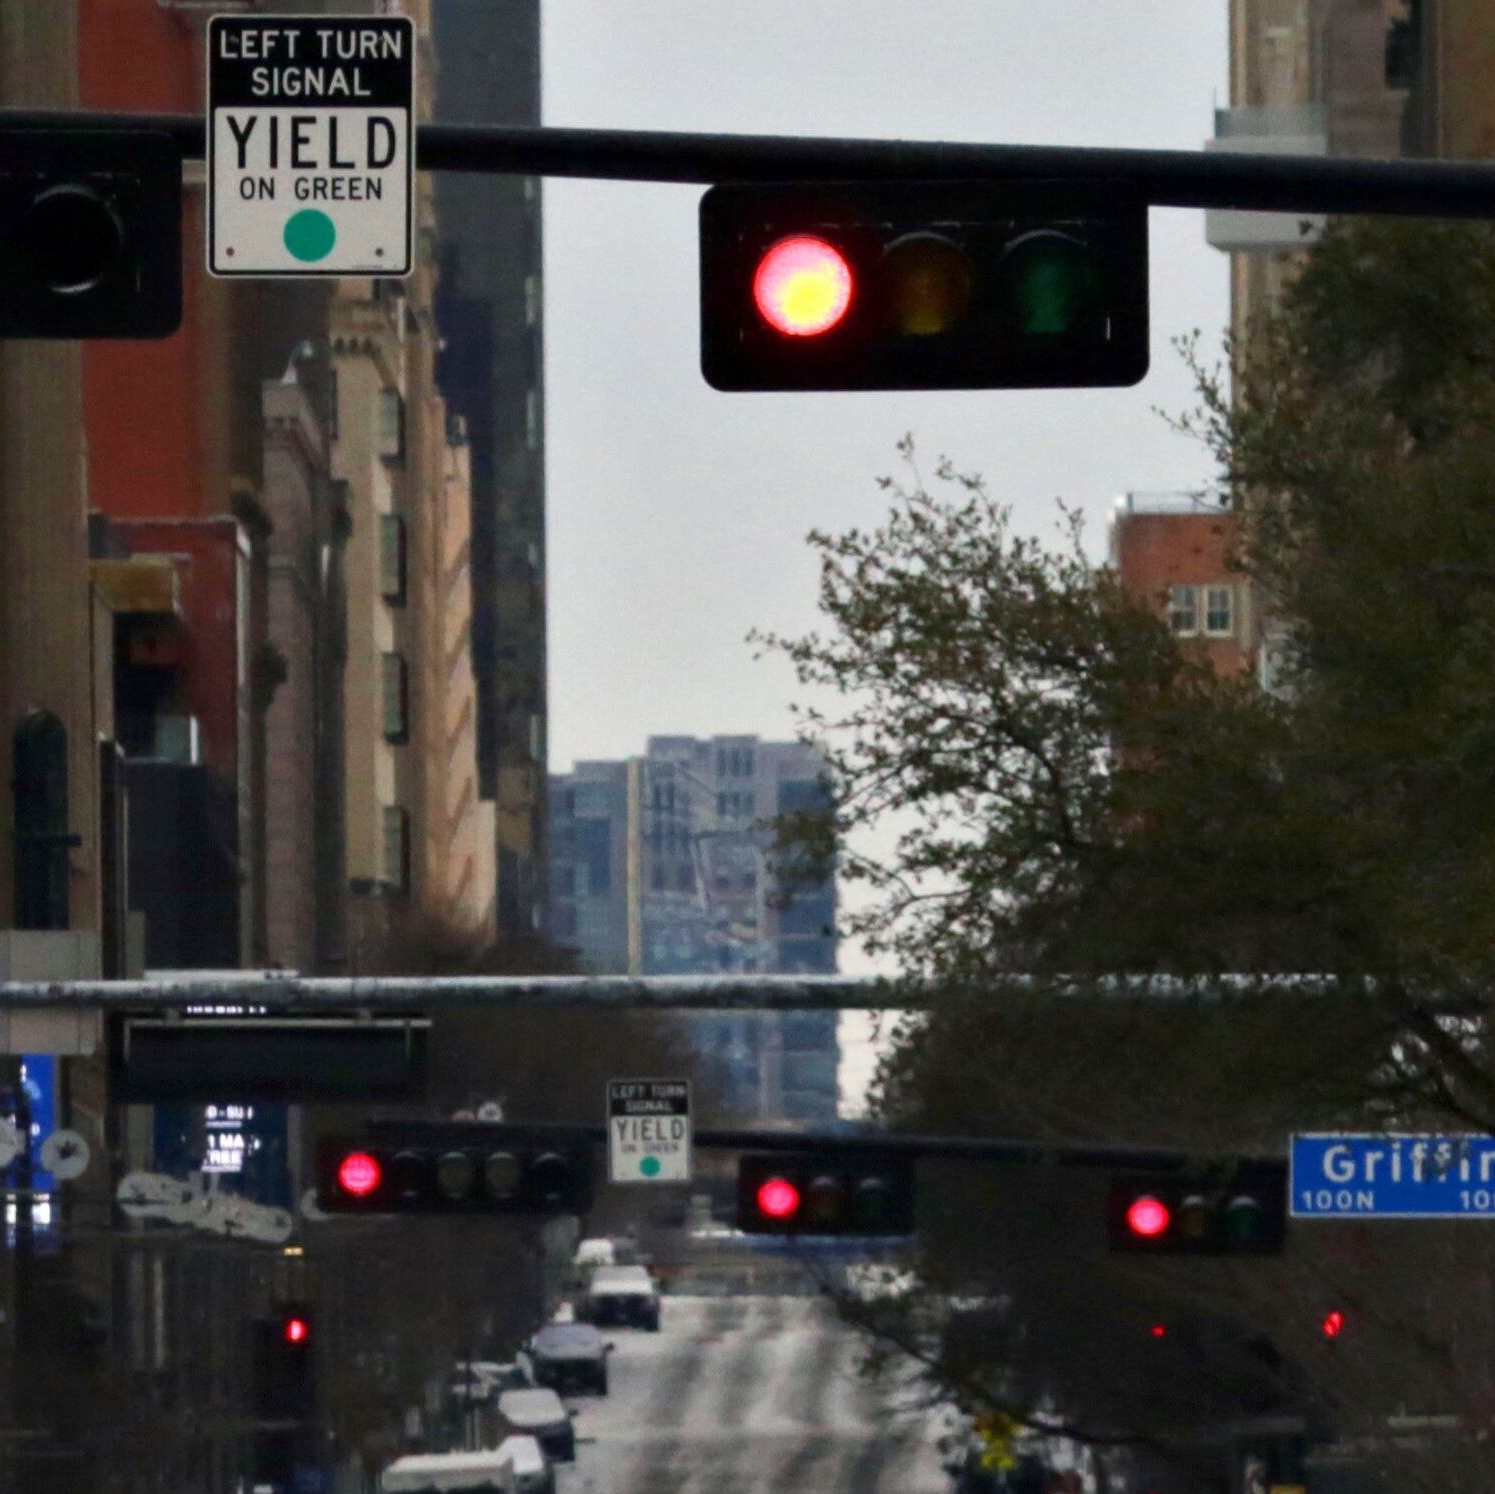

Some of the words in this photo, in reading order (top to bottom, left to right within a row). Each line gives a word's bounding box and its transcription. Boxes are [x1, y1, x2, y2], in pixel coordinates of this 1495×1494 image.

[220, 30, 300, 58] LEFT
[317, 30, 402, 59] TURN
[251, 67, 371, 96] SIGNAL
[226, 116, 397, 169] YIELD
[240, 177, 275, 200] ON
[294, 177, 383, 200] GREEN
[612, 1085, 645, 1098] LEFT
[617, 1118, 684, 1141] YIELD
[1302, 1190, 1375, 1210] 100N
